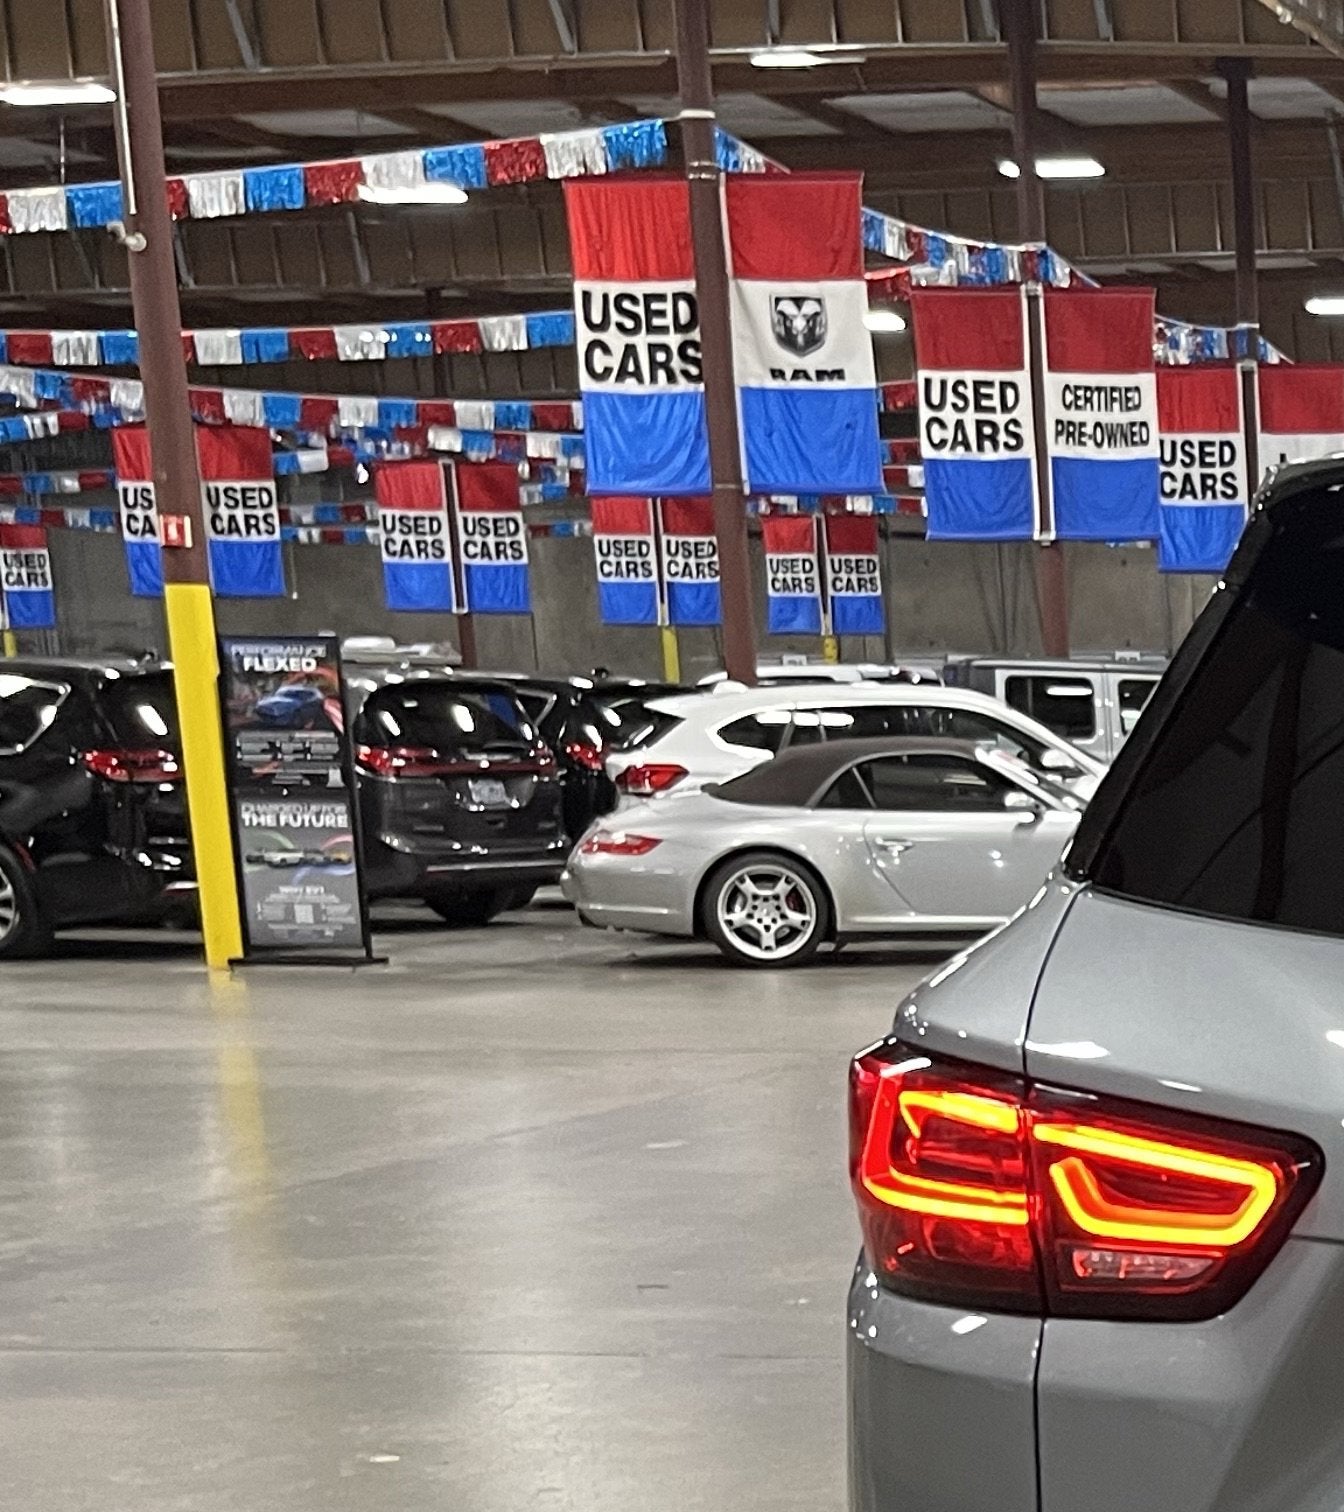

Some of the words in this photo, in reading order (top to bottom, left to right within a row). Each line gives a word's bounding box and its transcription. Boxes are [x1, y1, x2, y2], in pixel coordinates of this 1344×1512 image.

[581, 290, 698, 337] USED
[584, 339, 703, 385] CARS
[769, 368, 846, 382] RAM
[924, 378, 1020, 414] USED
[1061, 384, 1142, 412] CERTIFIED
[925, 417, 1024, 453] CARS
[1054, 419, 1150, 449] PRE-OWNED
[1159, 439, 1236, 469] USED
[1160, 471, 1239, 501] CARS
[122, 487, 154, 510] US
[206, 486, 273, 510] USED
[126, 513, 156, 536] CA
[210, 513, 276, 537] CARS
[382, 514, 442, 536] USED
[462, 516, 520, 538] USED
[384, 537, 445, 559] CARS
[463, 540, 524, 560] CARS
[597, 539, 651, 558] USED
[666, 539, 717, 559] USED
[3, 553, 46, 570] USED
[600, 560, 653, 579] CARS
[667, 560, 720, 579] CARS
[769, 558, 814, 574] USED
[830, 558, 877, 575] USED
[5, 571, 49, 587] CARS
[771, 577, 815, 593] CARS
[831, 577, 879, 593] CARS
[243, 656, 317, 672] FLEXED
[243, 812, 277, 827] THE
[279, 813, 348, 828] FUTURE
